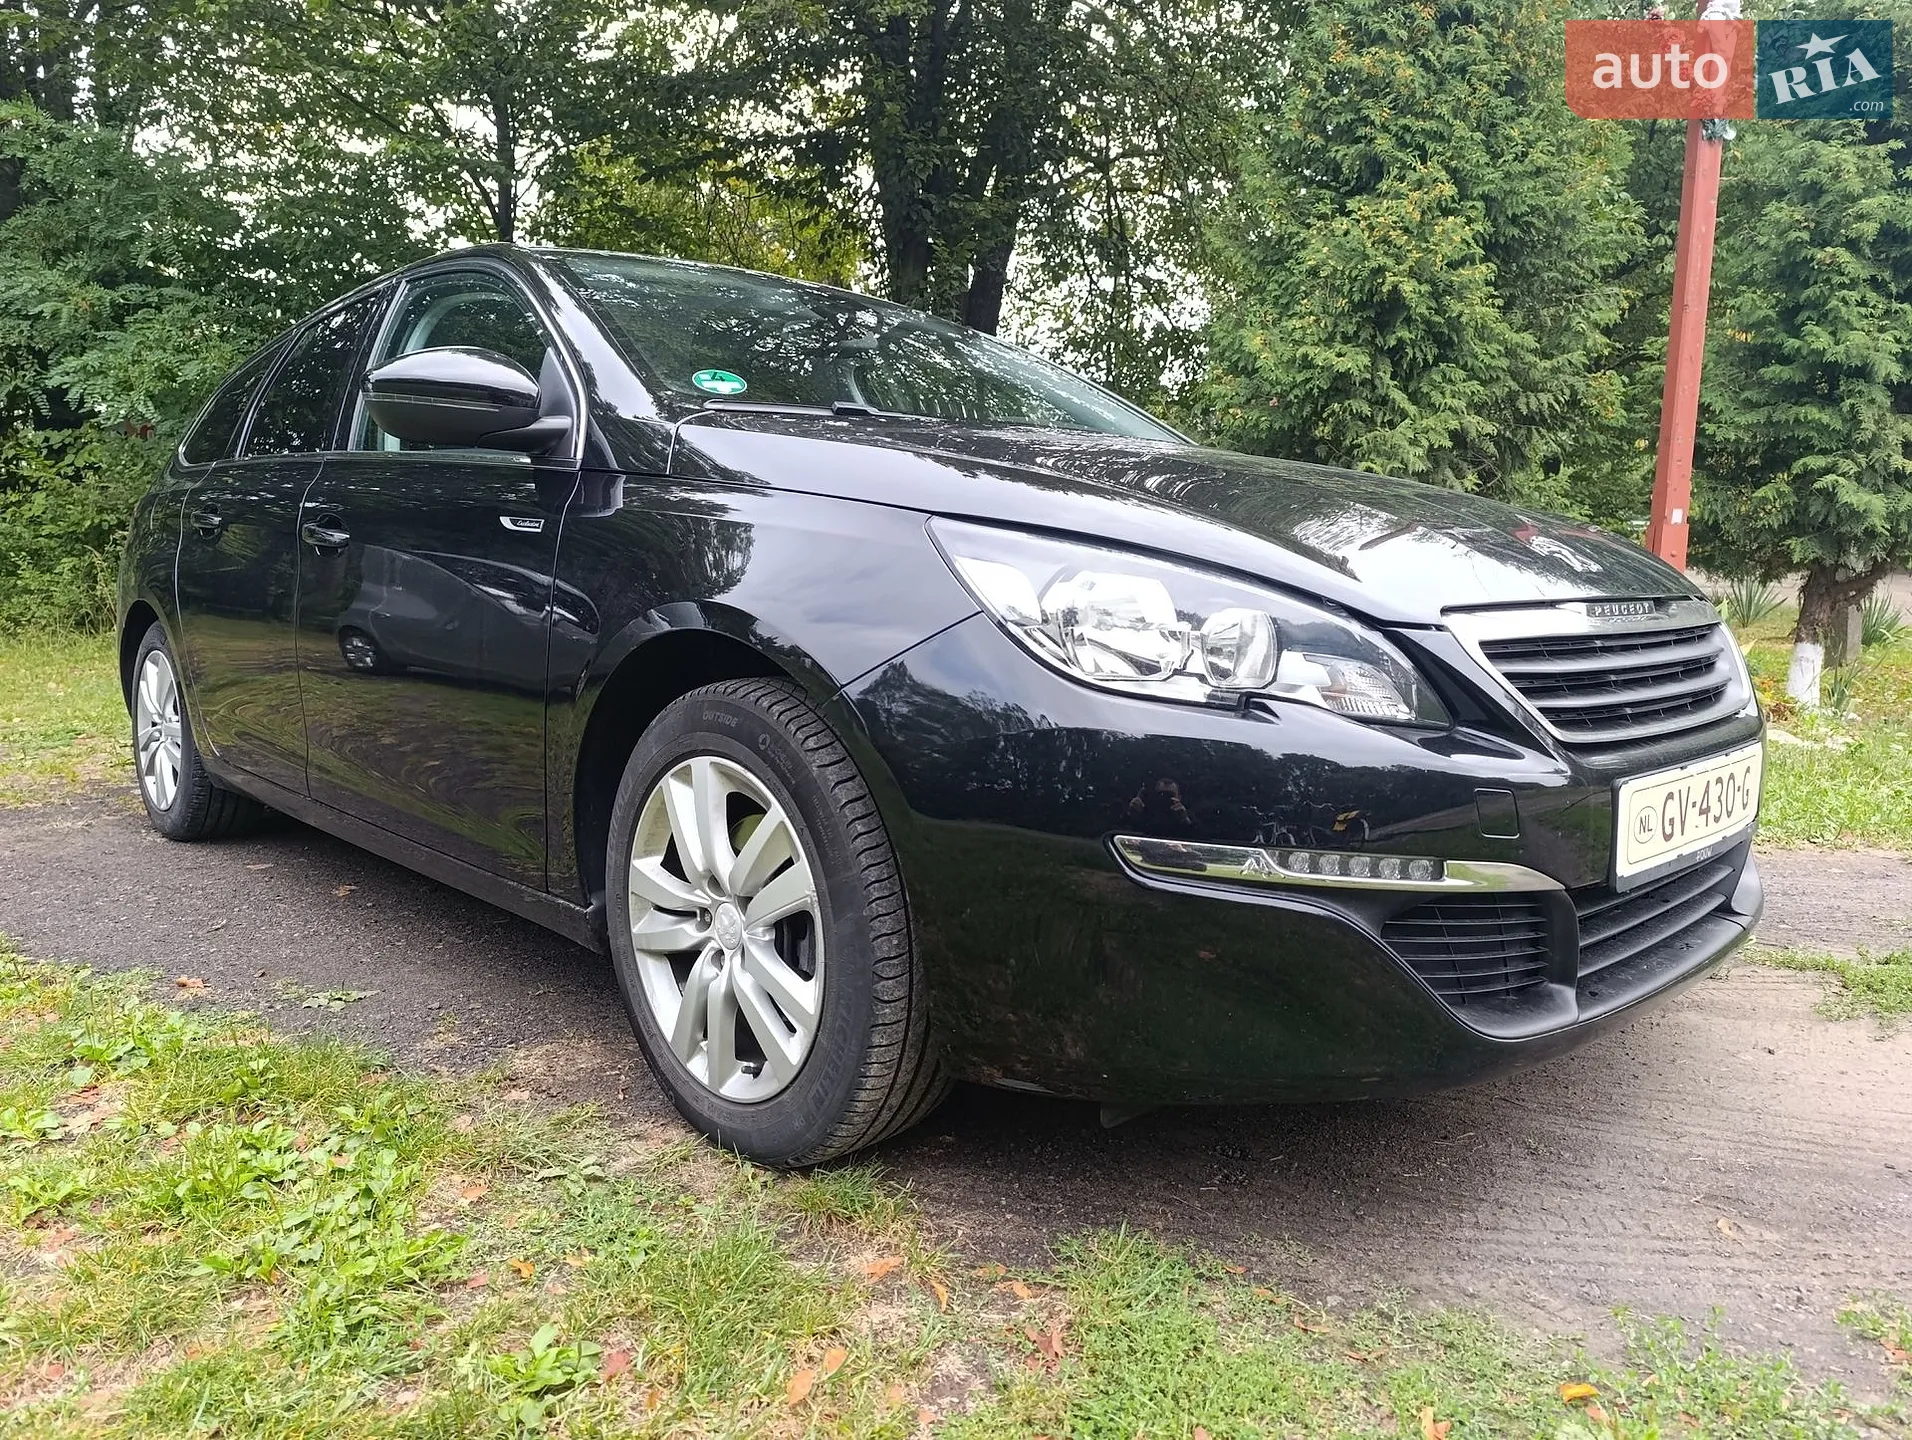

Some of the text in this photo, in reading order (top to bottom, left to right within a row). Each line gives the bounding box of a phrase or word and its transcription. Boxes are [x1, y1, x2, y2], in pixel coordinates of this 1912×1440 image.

[1594, 602, 1649, 616] PEUGEOT
[702, 710, 740, 728] OUTSIDE
[1639, 765, 1751, 842] NL GV-430-G
